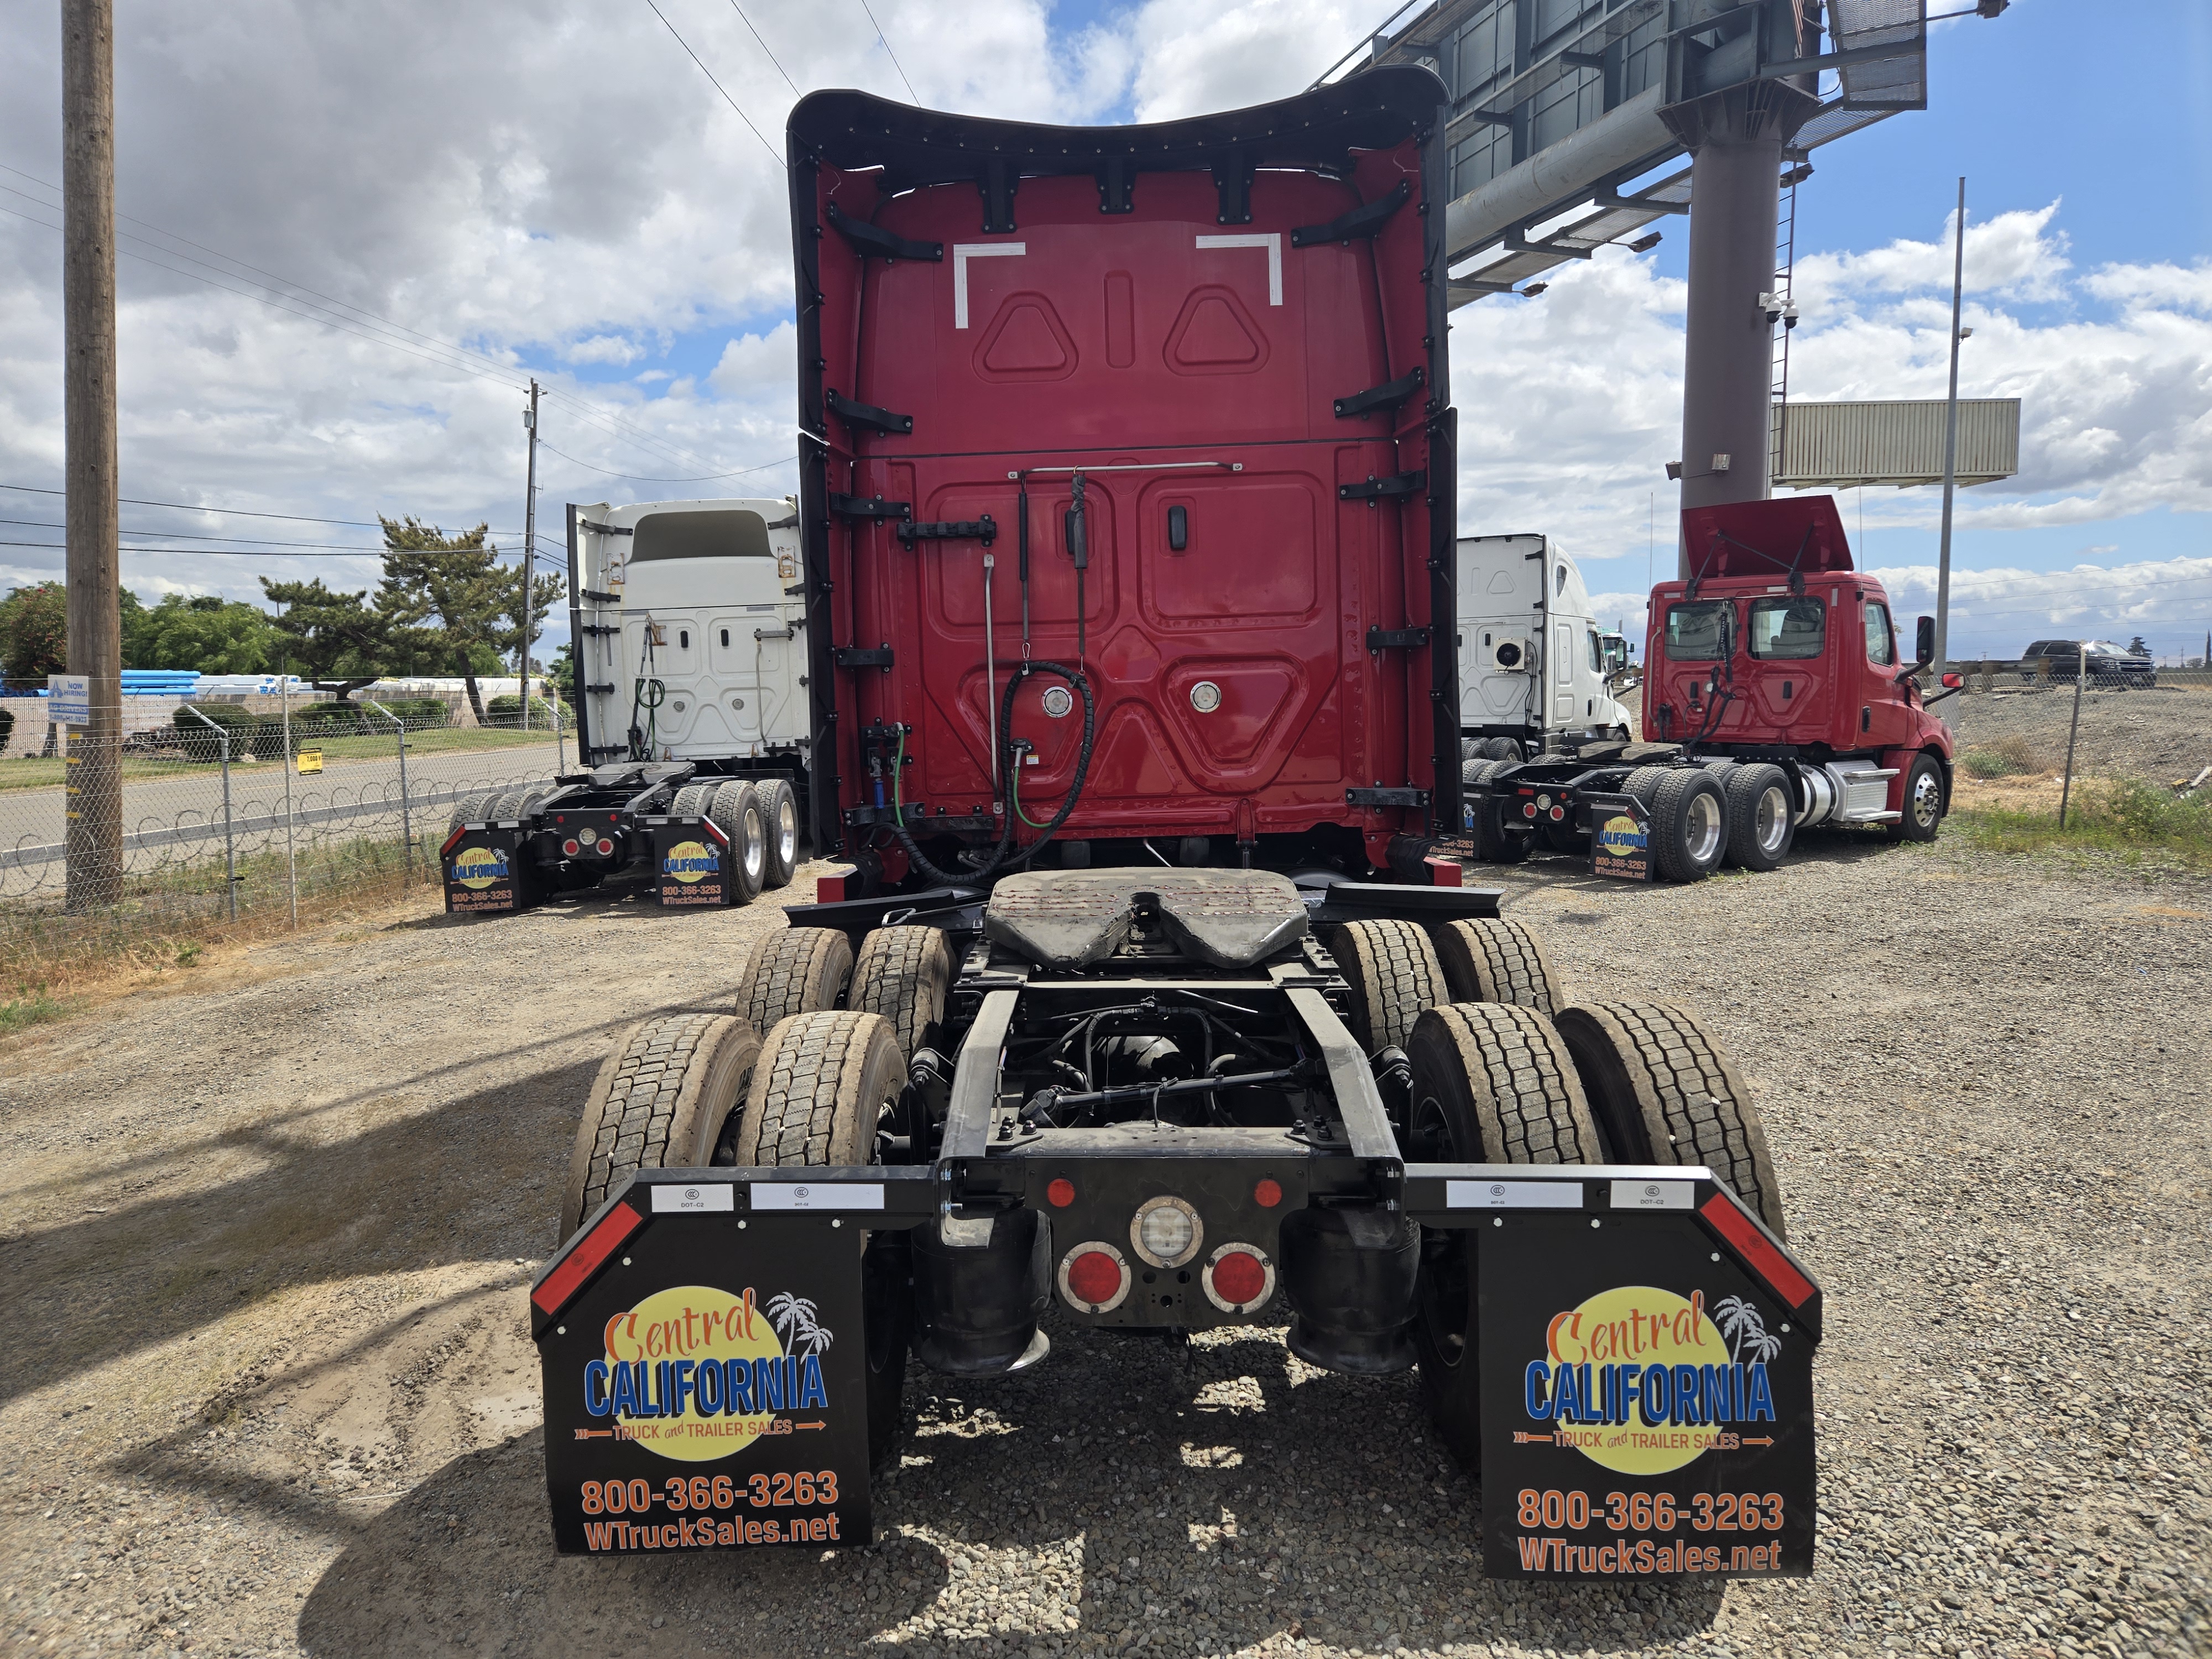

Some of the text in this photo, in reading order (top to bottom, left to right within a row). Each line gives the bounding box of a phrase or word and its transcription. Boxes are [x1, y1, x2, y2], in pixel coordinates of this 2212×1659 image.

[60, 705, 87, 713] DRIVERS
[1604, 820, 1635, 833] Central
[1599, 830, 1647, 847] CALIFORNIA
[456, 847, 492, 866] Central
[668, 841, 703, 859] Central
[451, 862, 509, 879] CALIFORNIA
[664, 857, 719, 873] CALIFORNIA
[1595, 857, 1646, 870] 800-366-3263
[1595, 866, 1646, 879] WTruckSales.net
[452, 889, 512, 902] 800-366-3263
[662, 884, 721, 896] 800-366-3263
[452, 900, 513, 912] WTruckSales.net
[662, 895, 721, 905] WTruckSales.net
[604, 1287, 760, 1365] Central
[1547, 1289, 1707, 1368] Central
[584, 1354, 828, 1418] CALIFORNIA
[1525, 1360, 1776, 1425] CALIFORNIA
[612, 1419, 792, 1441] TRUCK and TRAILER SALES
[1553, 1428, 1740, 1449] TRUCK and TRAILER SALES
[581, 1470, 839, 1515] 800-366-3263
[1517, 1489, 1784, 1531] 800-366-3263
[583, 1512, 841, 1551] WTruckSales.net
[1517, 1536, 1782, 1574] WTruckSales.net
